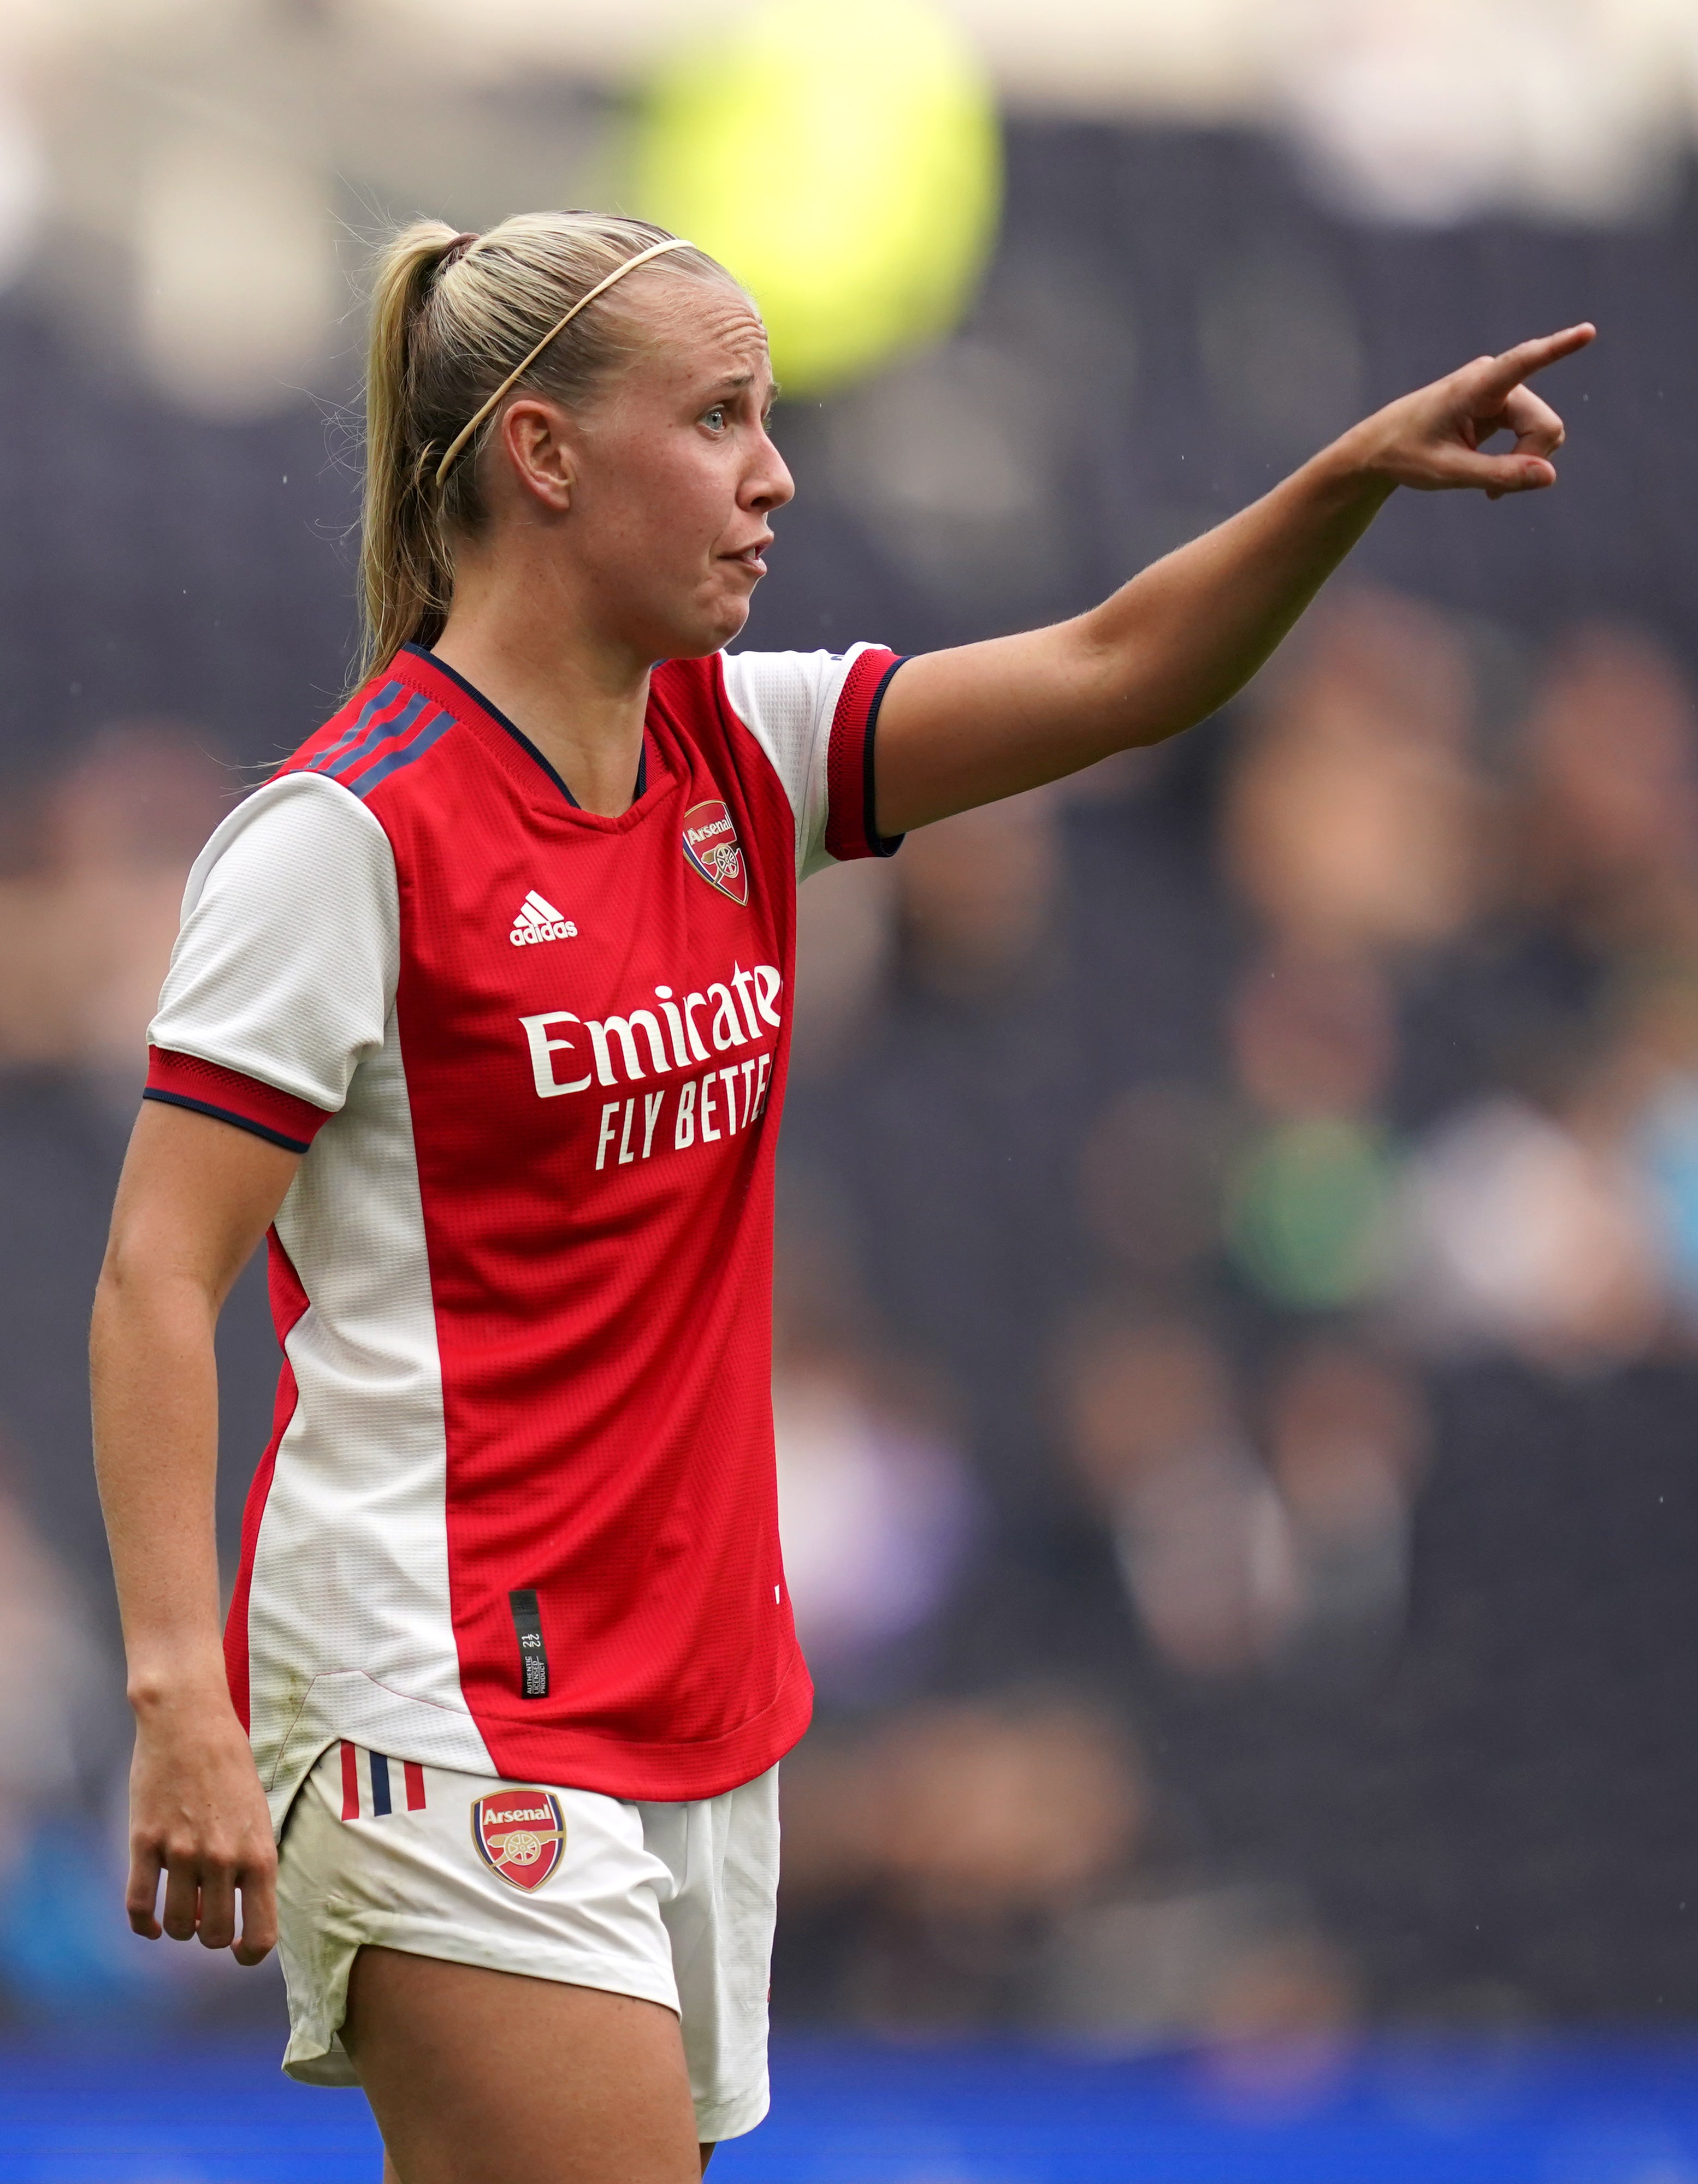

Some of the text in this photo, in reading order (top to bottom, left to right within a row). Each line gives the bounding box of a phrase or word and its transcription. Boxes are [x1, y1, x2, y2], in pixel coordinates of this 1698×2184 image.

[687, 814, 732, 846] Arsenal
[510, 921, 578, 947] adidas
[518, 959, 783, 1099] Emirate
[595, 1053, 770, 1171] FLY BETTE
[521, 1634, 532, 1648] 21
[483, 1803, 552, 1825] Arsenal
